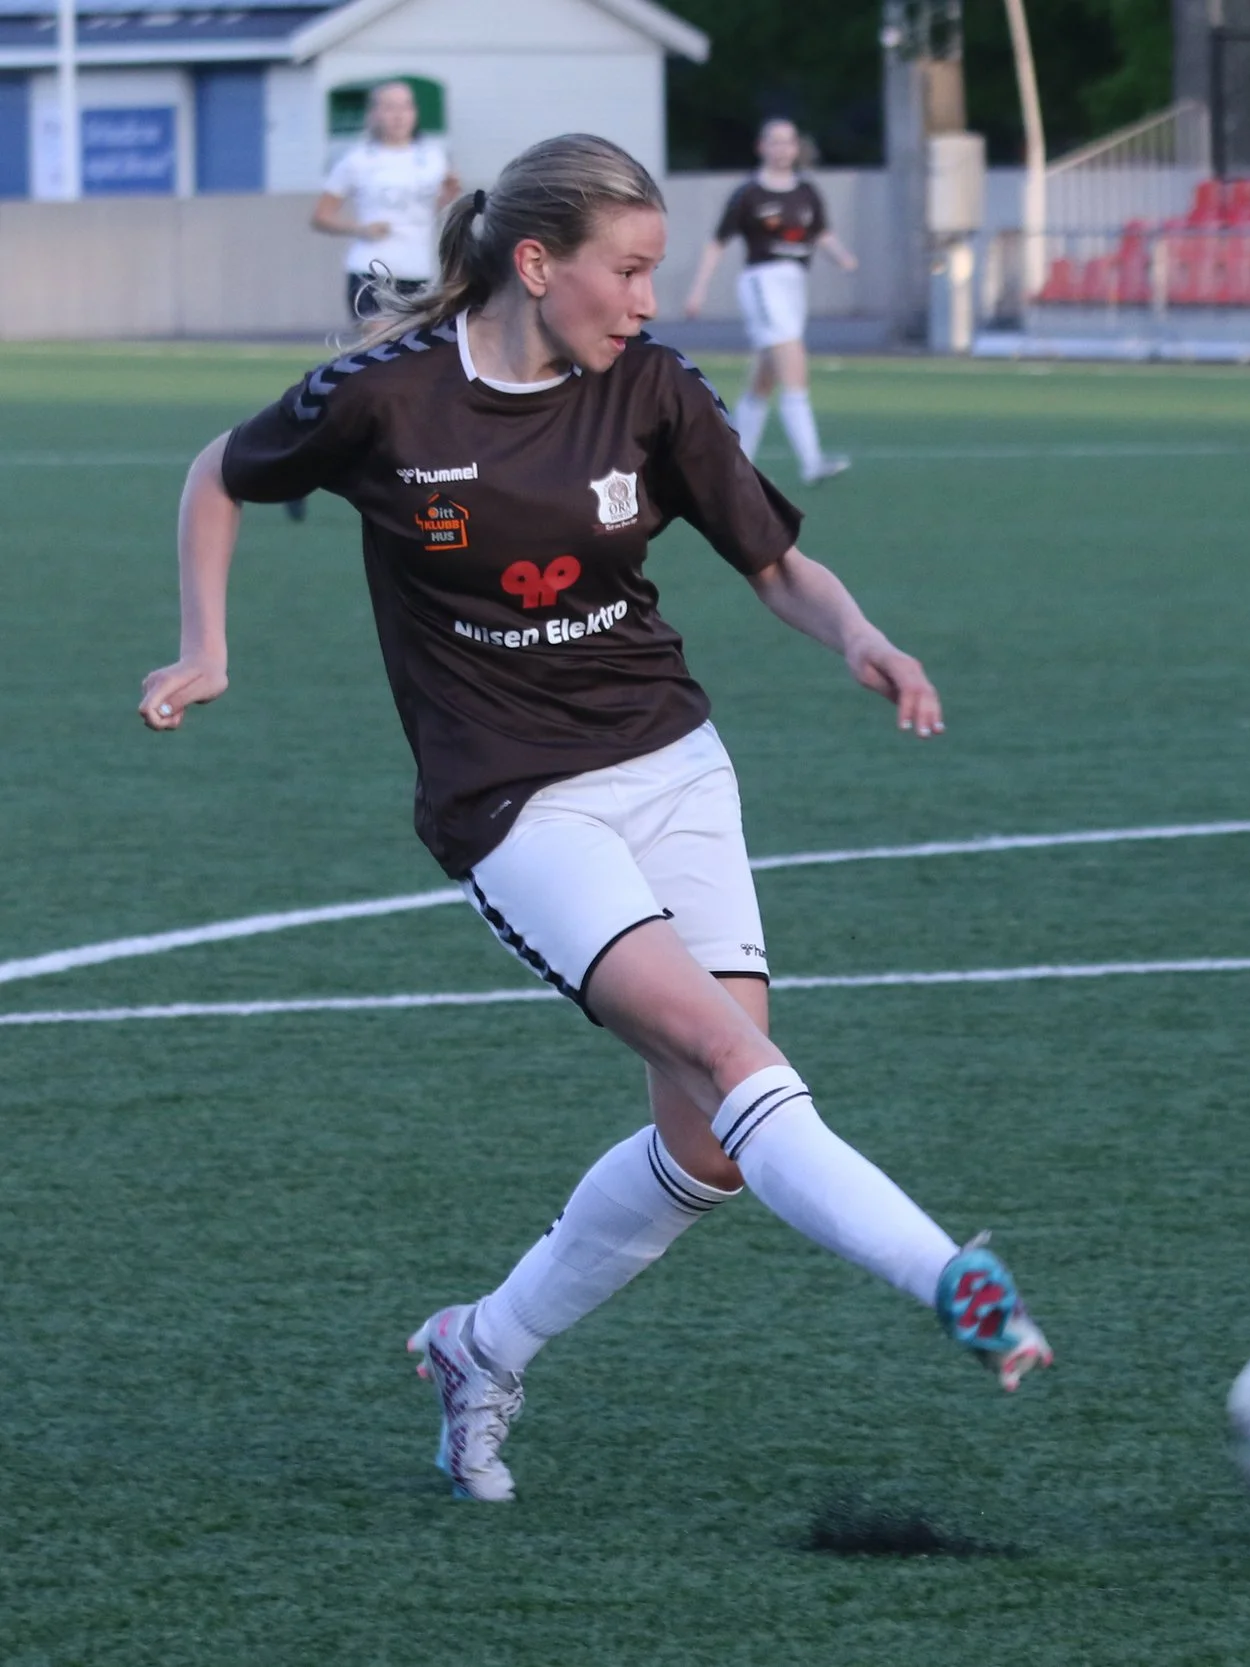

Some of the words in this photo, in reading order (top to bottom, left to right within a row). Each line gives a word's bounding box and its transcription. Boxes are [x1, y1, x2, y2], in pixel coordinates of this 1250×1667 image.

[415, 462, 478, 484] hummel
[424, 519, 460, 530] KLUBB
[431, 531, 455, 542] HUS
[545, 600, 628, 645] Elektro
